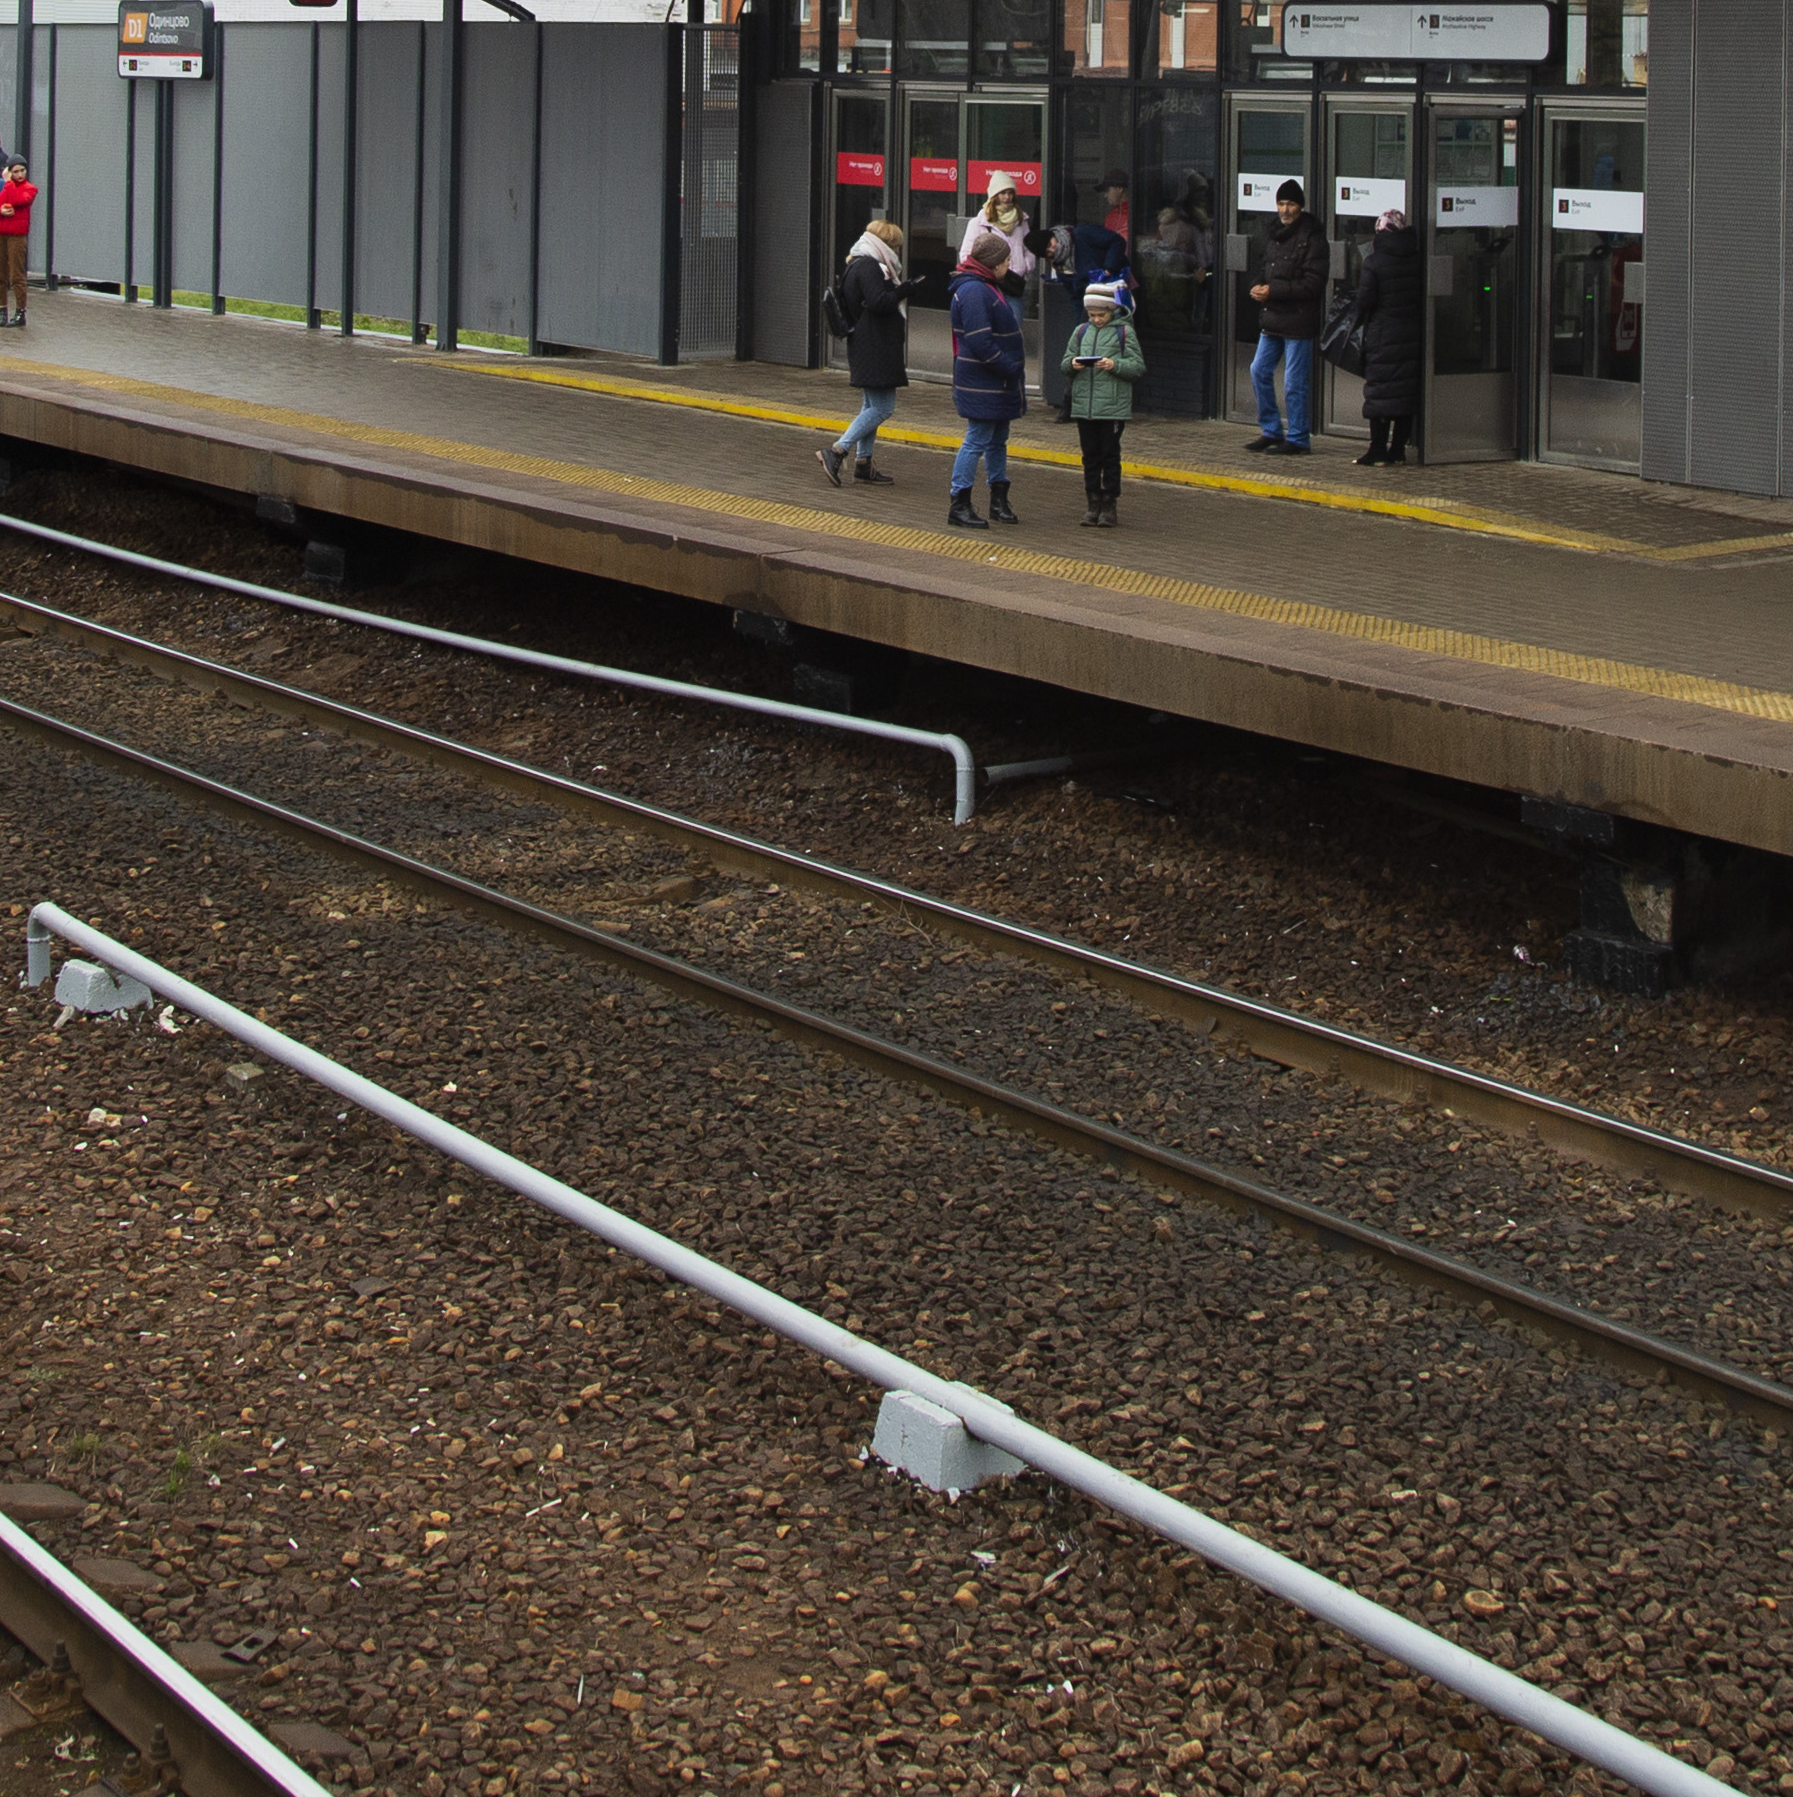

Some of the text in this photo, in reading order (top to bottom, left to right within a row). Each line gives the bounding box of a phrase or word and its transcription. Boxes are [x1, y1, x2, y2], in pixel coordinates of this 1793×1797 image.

[128, 18, 143, 38] D1
[148, 12, 190, 30] Одинцово
[148, 32, 179, 44] Odintsovo
